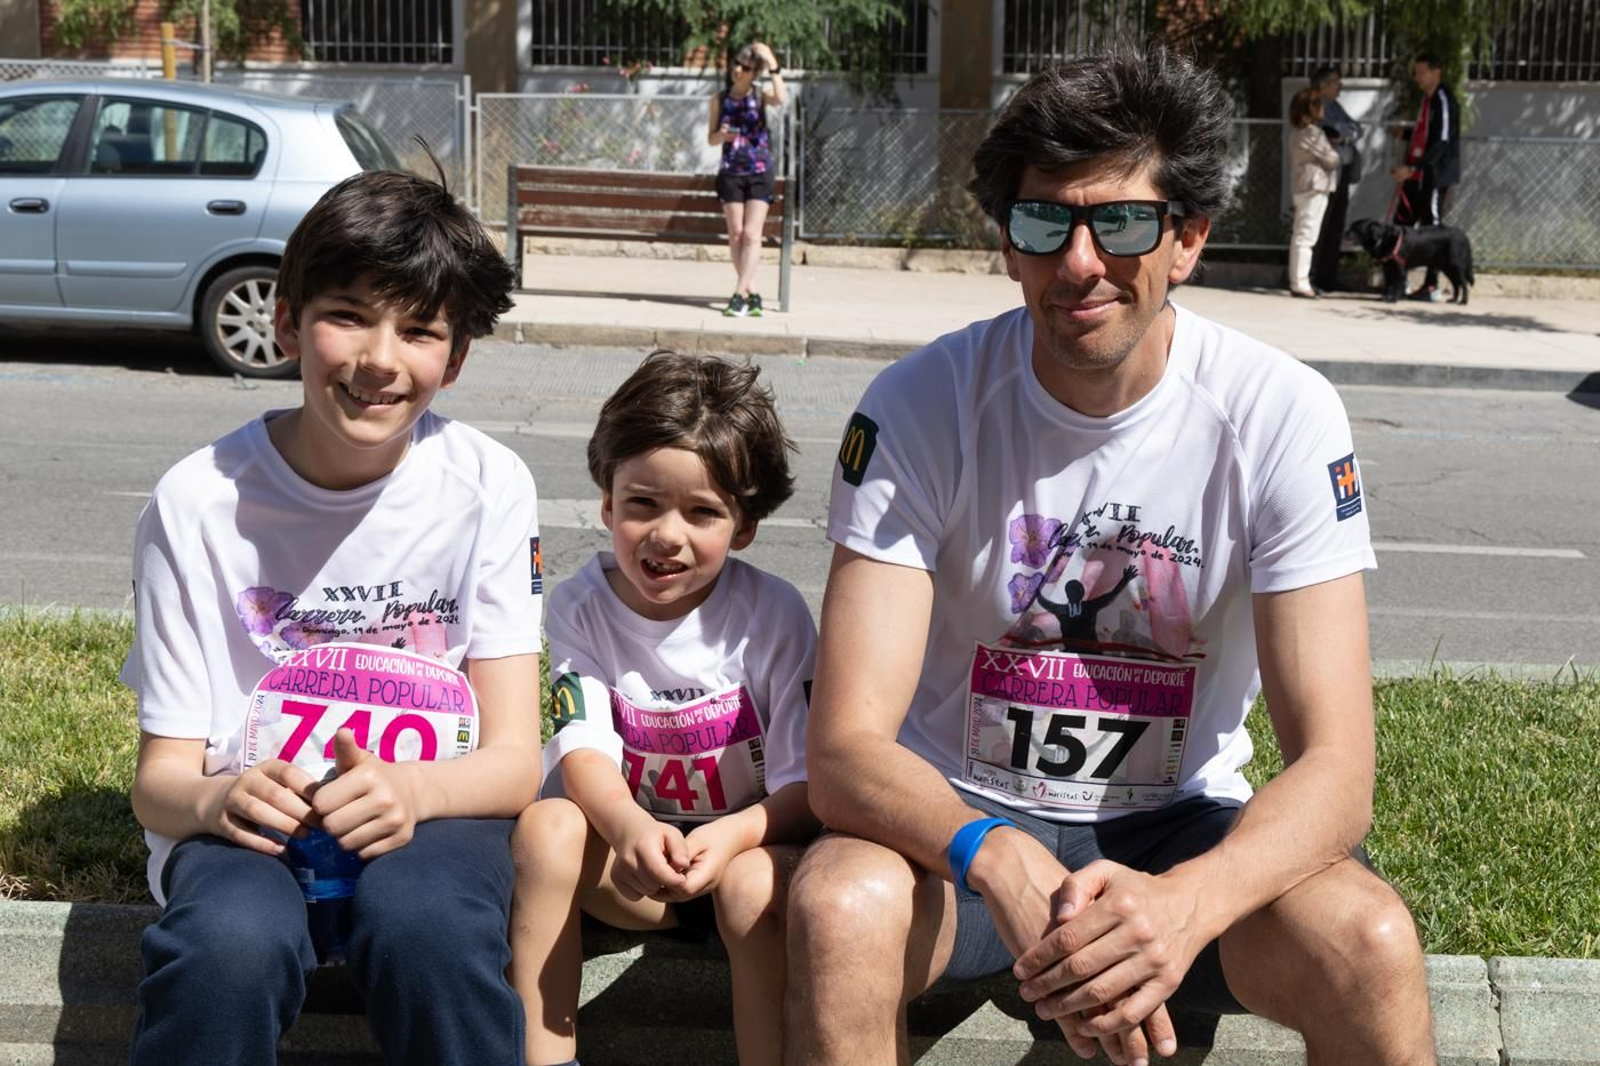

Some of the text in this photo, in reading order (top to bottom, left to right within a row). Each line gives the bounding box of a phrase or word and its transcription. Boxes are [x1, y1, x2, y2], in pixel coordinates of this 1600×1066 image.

[1151, 551, 1164, 560] de
[323, 580, 404, 602] XXVII
[366, 626, 378, 634] de
[382, 620, 413, 632] mayo
[418, 617, 430, 625] de
[355, 654, 416, 676] EDUCACIÓN
[981, 650, 1066, 680] XXVII
[1073, 662, 1133, 682] EDUCACIÓN
[1143, 668, 1186, 687] DEPORTE
[269, 668, 465, 713] CARRERA POPULAR
[981, 673, 1183, 717] CARRERA POPULAR
[278, 699, 438, 765] 740
[641, 711, 695, 729] EDUCACIÓN
[659, 717, 750, 753] POPULAR
[1007, 706, 1152, 780] 157
[1048, 790, 1080, 800] maristas
